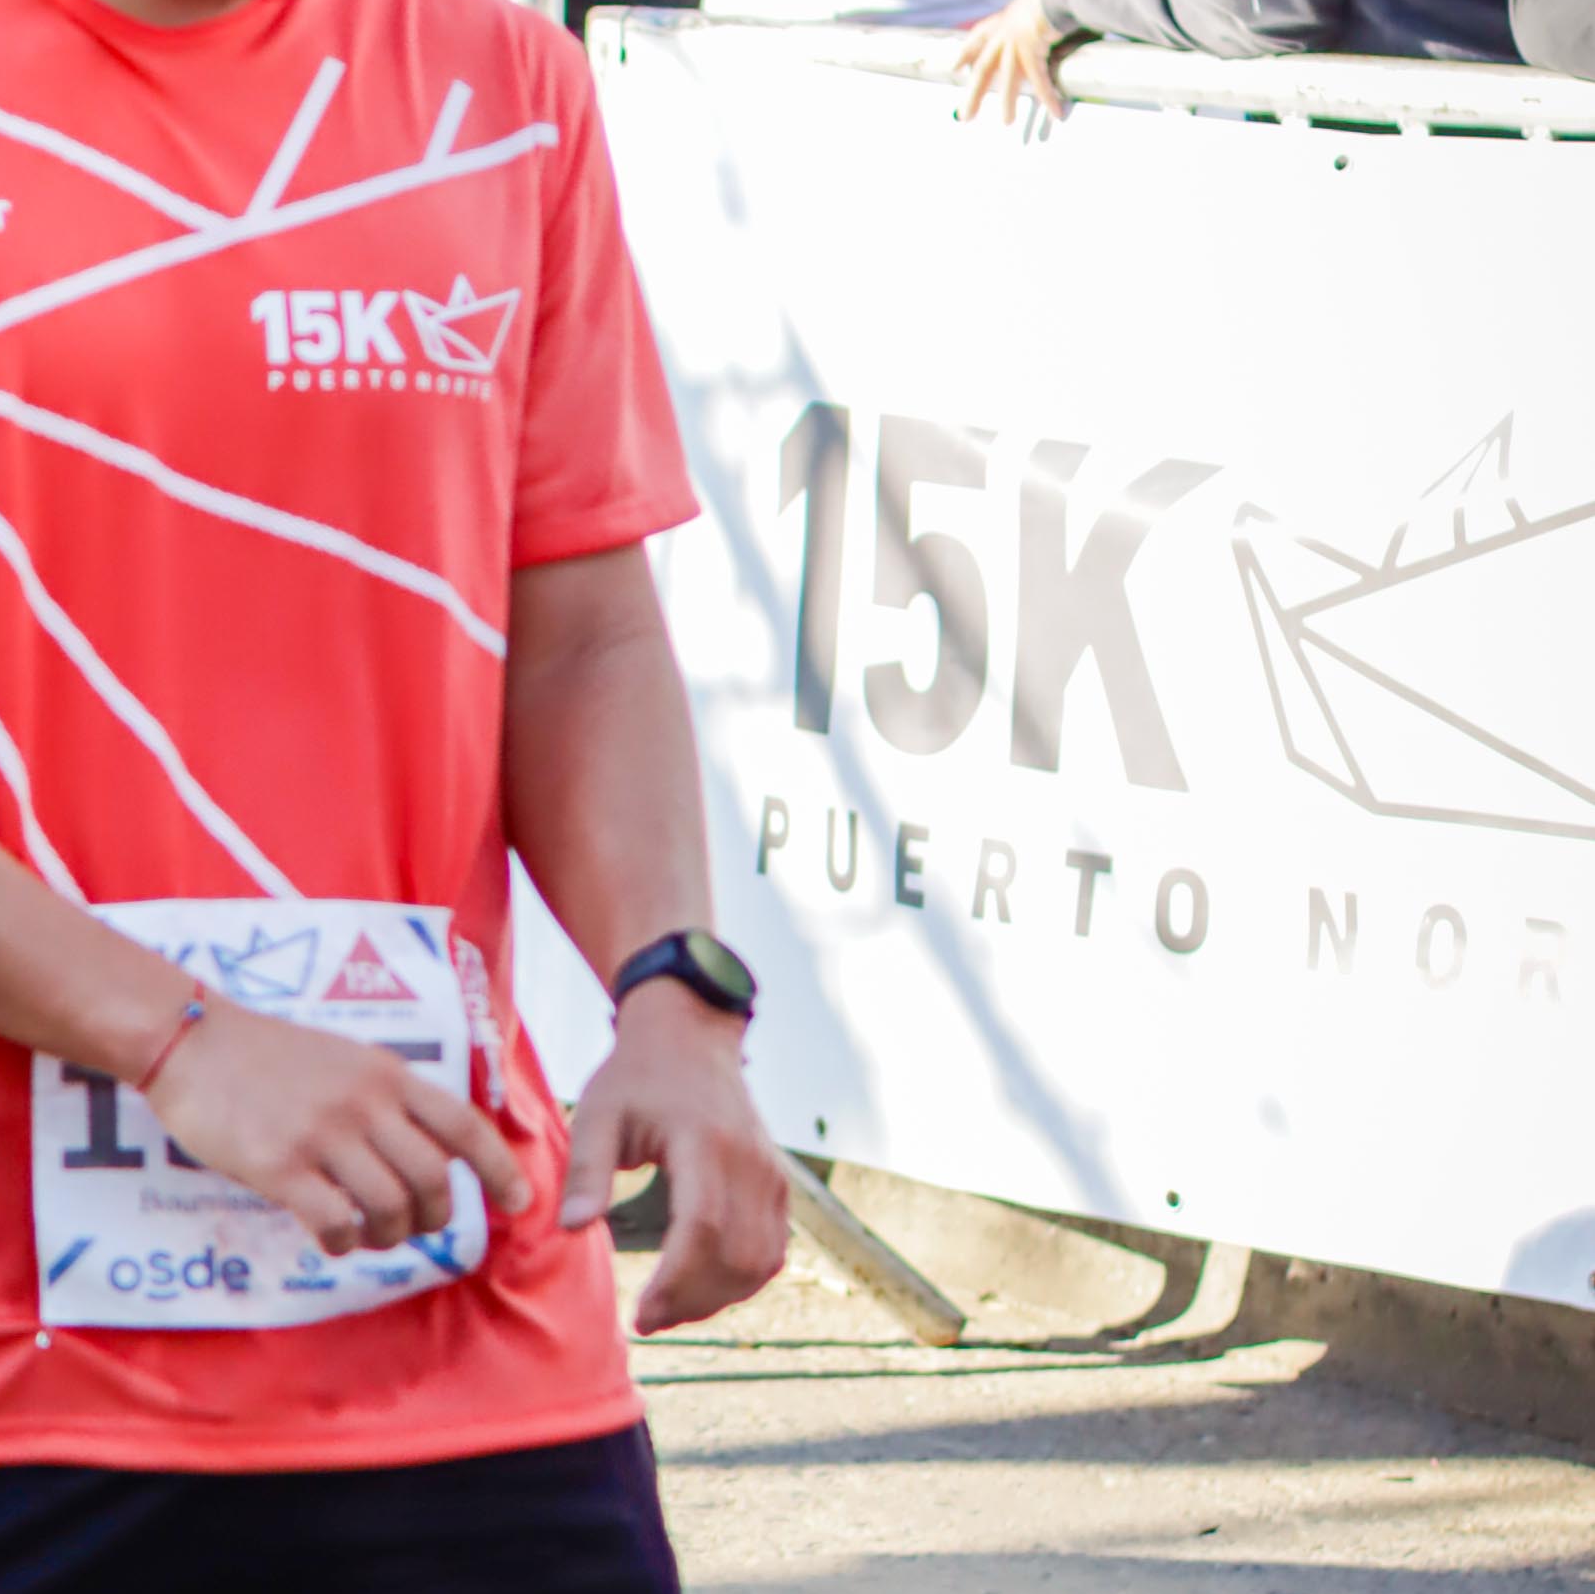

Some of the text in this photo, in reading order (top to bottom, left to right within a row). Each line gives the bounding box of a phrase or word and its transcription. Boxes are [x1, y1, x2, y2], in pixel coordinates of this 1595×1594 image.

[251, 290, 405, 365] 15K
[267, 369, 406, 392] PUERTO
[777, 400, 1224, 793] 15K
[756, 796, 1209, 954] PUERTO
[109, 1246, 251, 1295] osde
